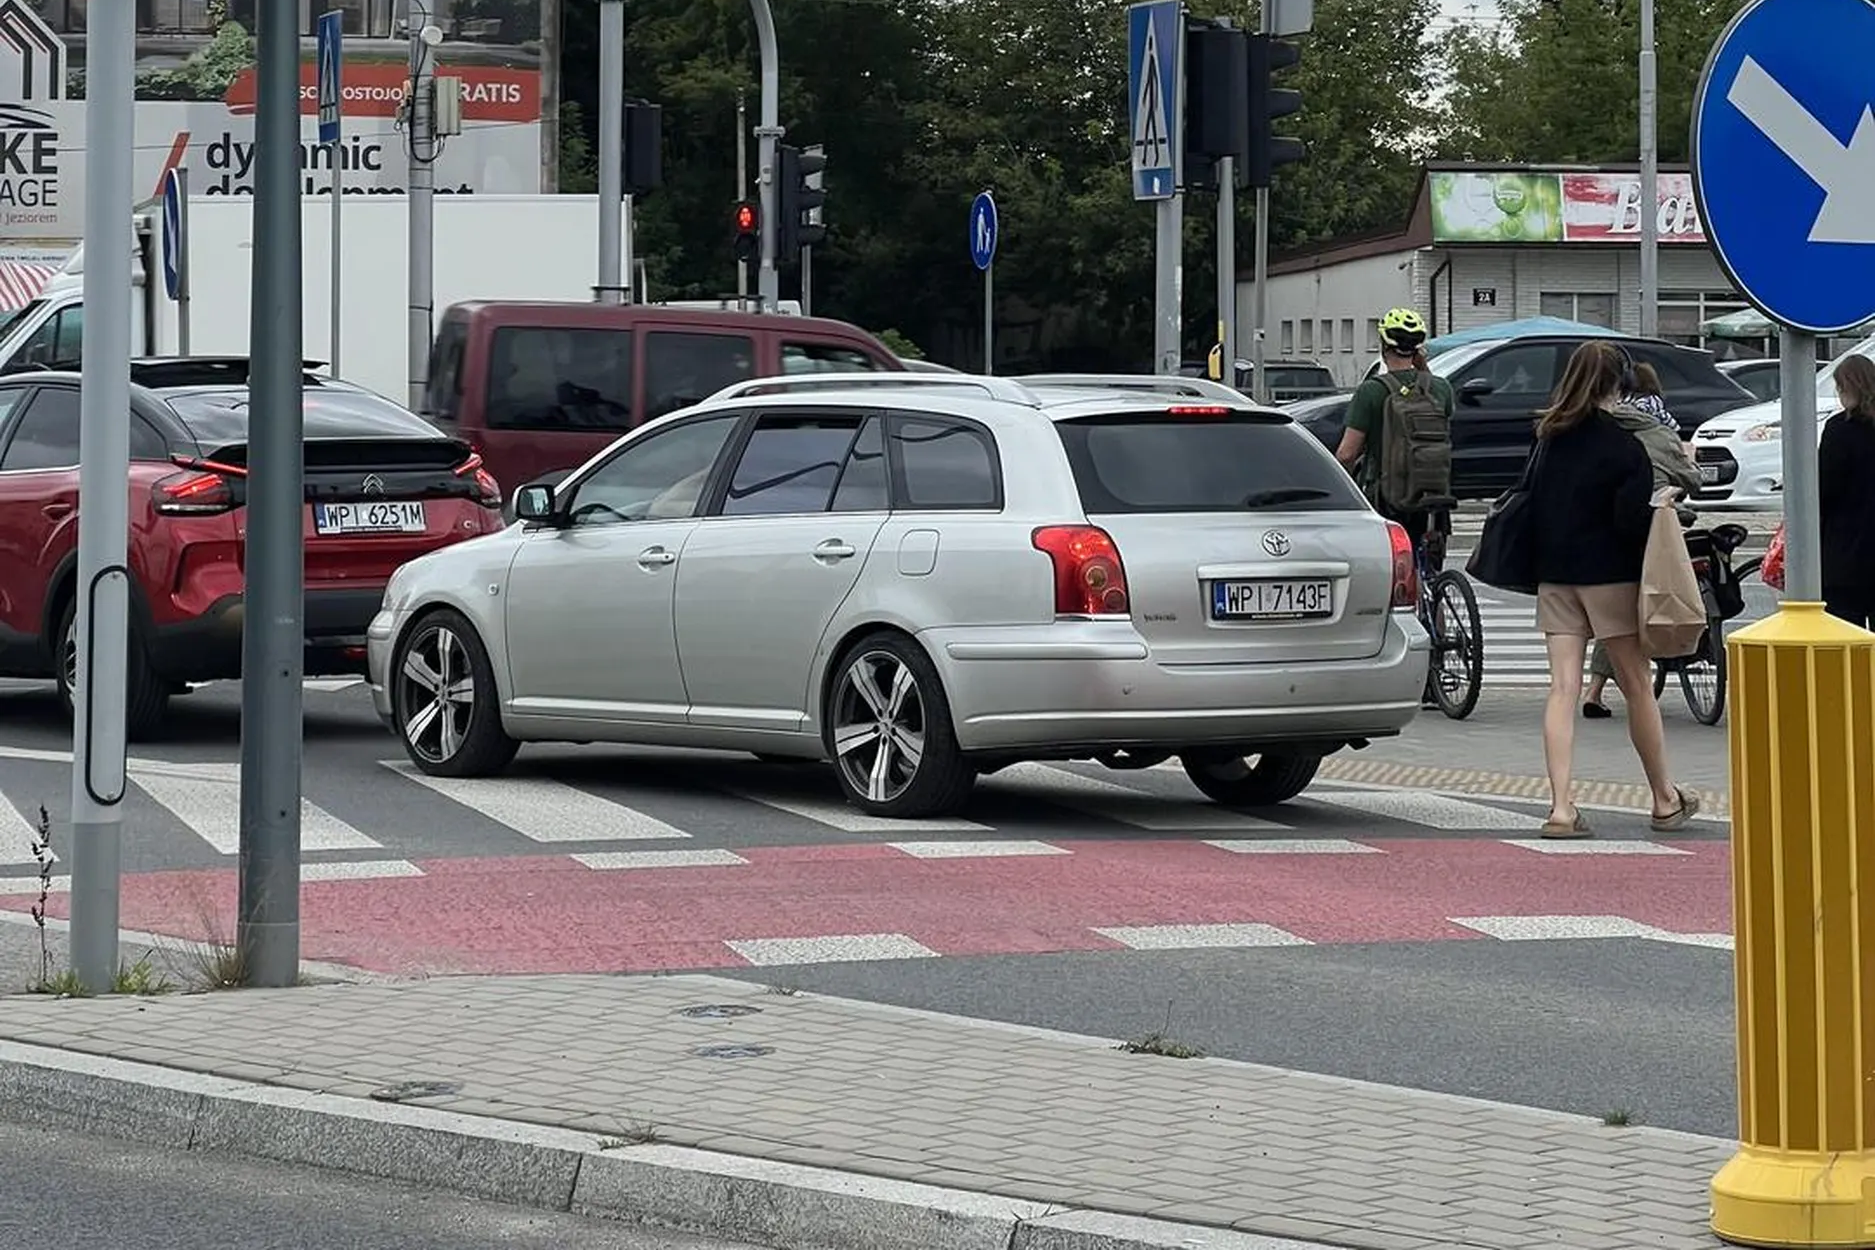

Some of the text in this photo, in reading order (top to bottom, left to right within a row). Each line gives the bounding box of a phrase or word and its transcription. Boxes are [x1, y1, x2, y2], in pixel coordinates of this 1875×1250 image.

[206, 132, 382, 179] dymic
[326, 504, 422, 527] WPI 6251M
[1227, 584, 1328, 612] WPI 7143F
